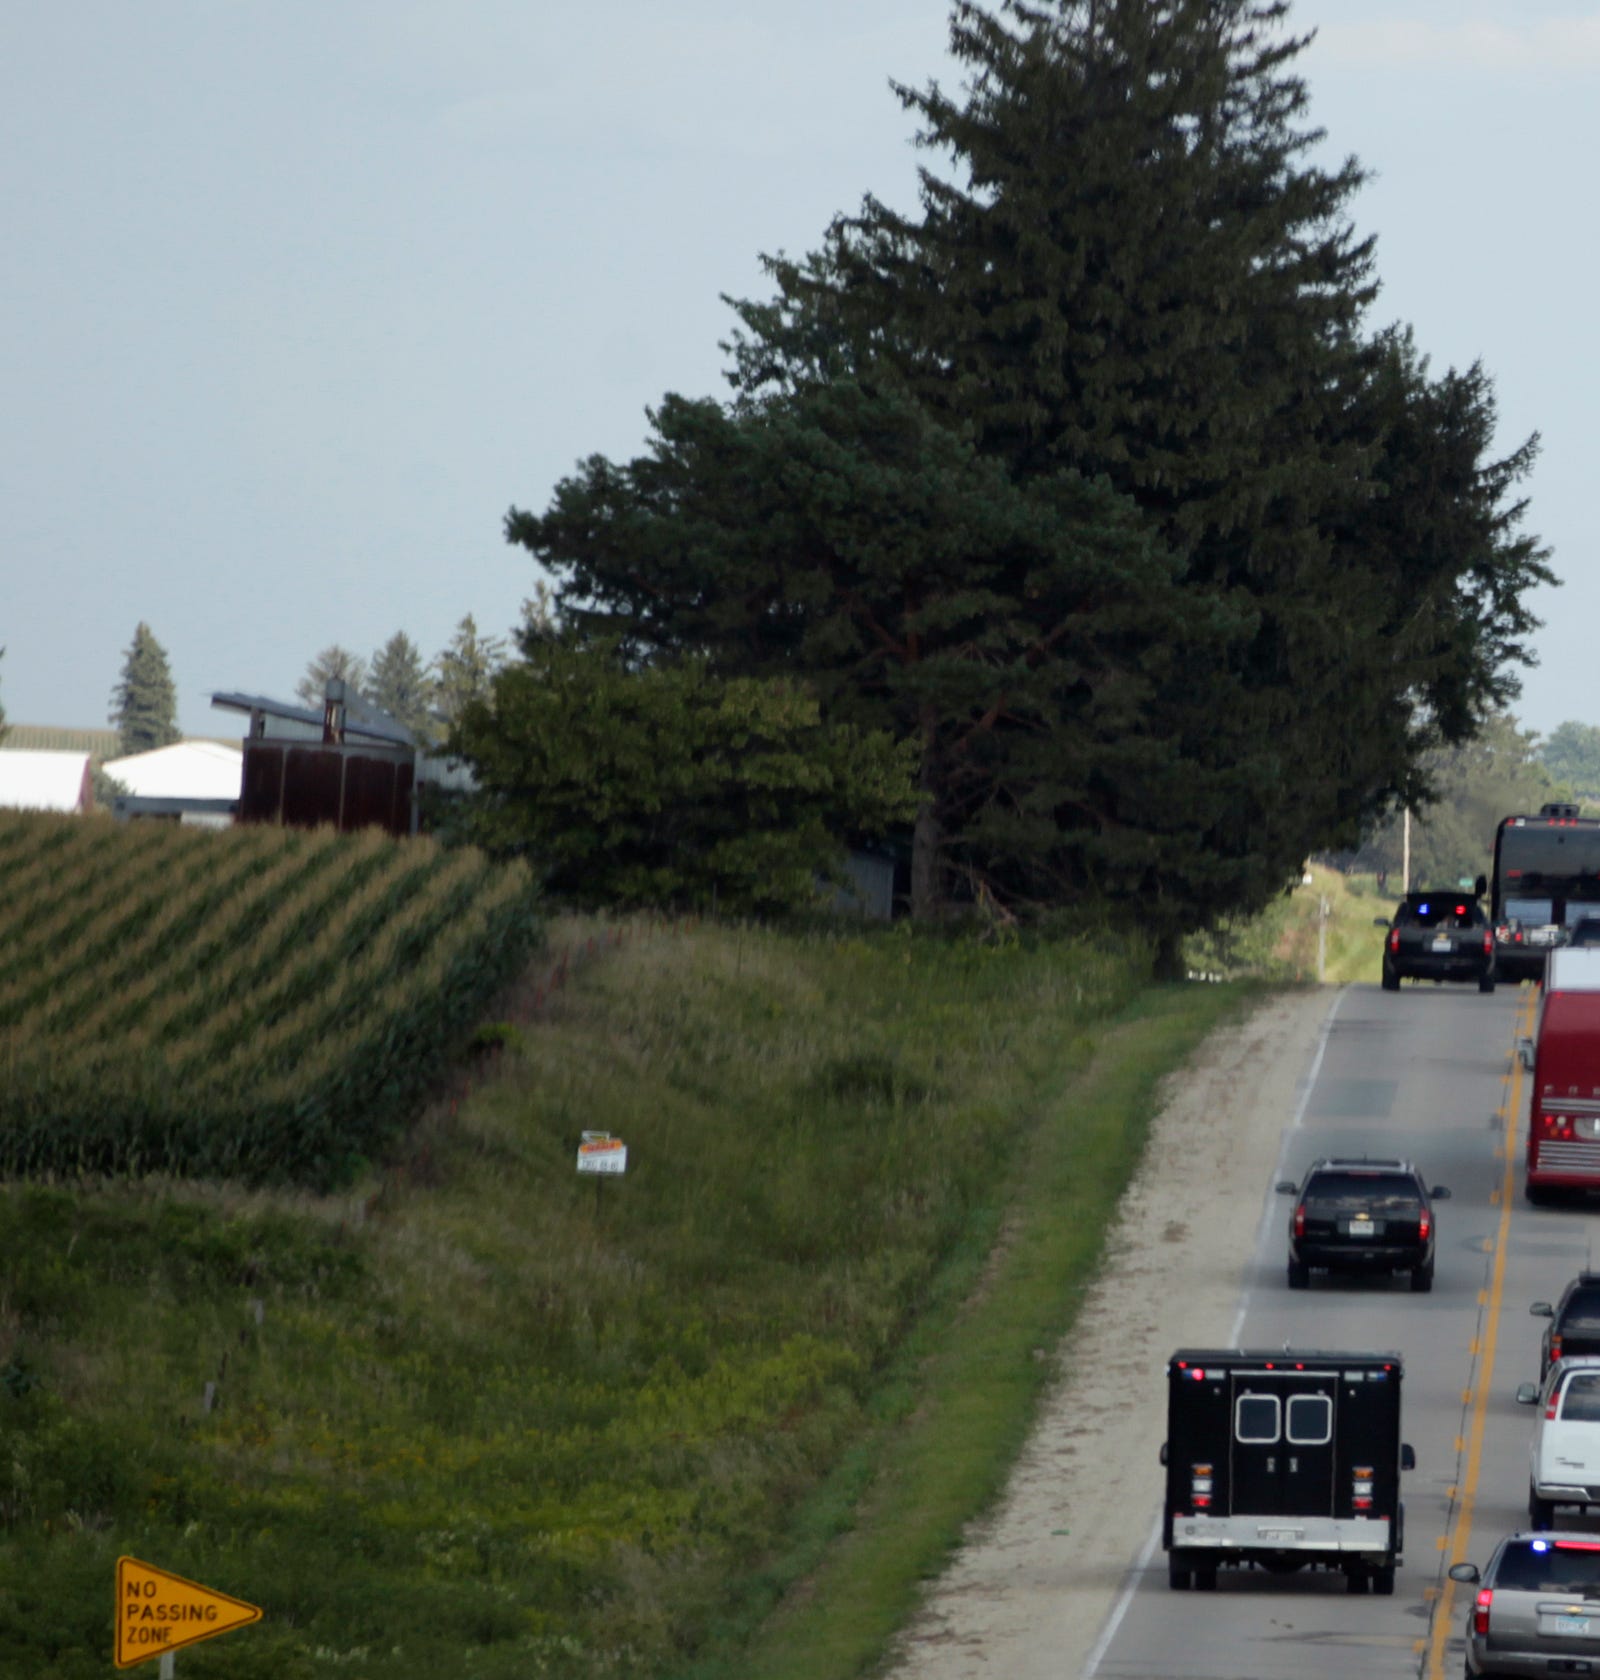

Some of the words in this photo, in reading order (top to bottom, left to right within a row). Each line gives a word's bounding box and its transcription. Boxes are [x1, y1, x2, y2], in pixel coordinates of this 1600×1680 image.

[127, 1581, 157, 1598] NO
[127, 1604, 217, 1621] PASSING
[127, 1626, 172, 1644] ZONE
